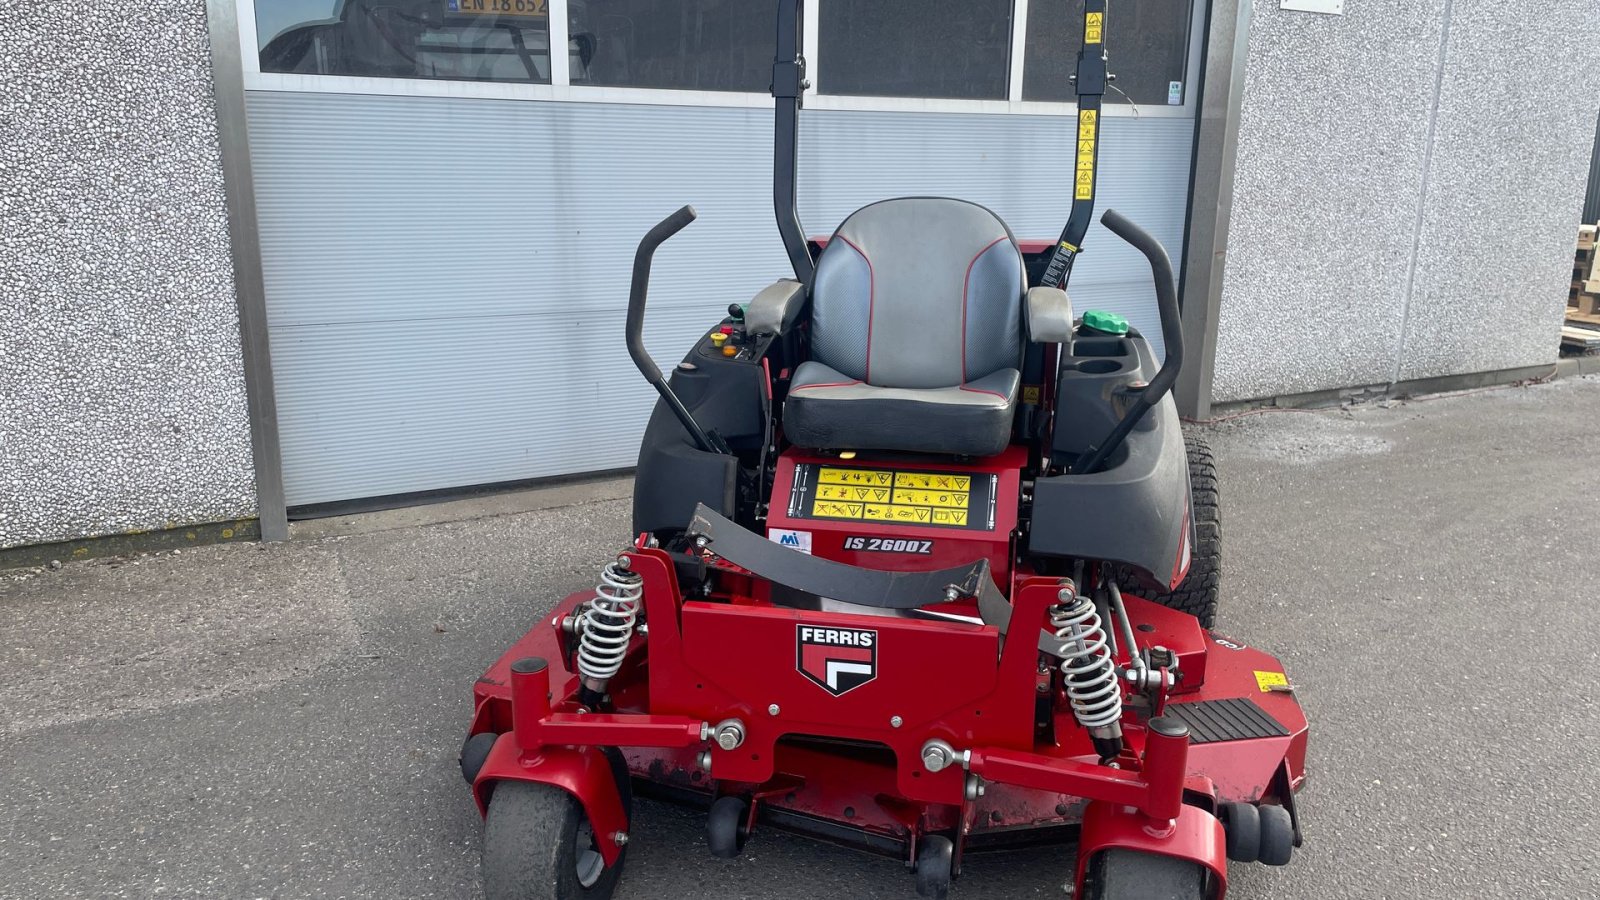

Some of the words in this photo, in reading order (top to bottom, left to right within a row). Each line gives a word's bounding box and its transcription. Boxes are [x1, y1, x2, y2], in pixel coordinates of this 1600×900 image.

[844, 537, 865, 549] IS
[867, 539, 932, 553] 2600Z
[801, 627, 873, 647] FERRIS
